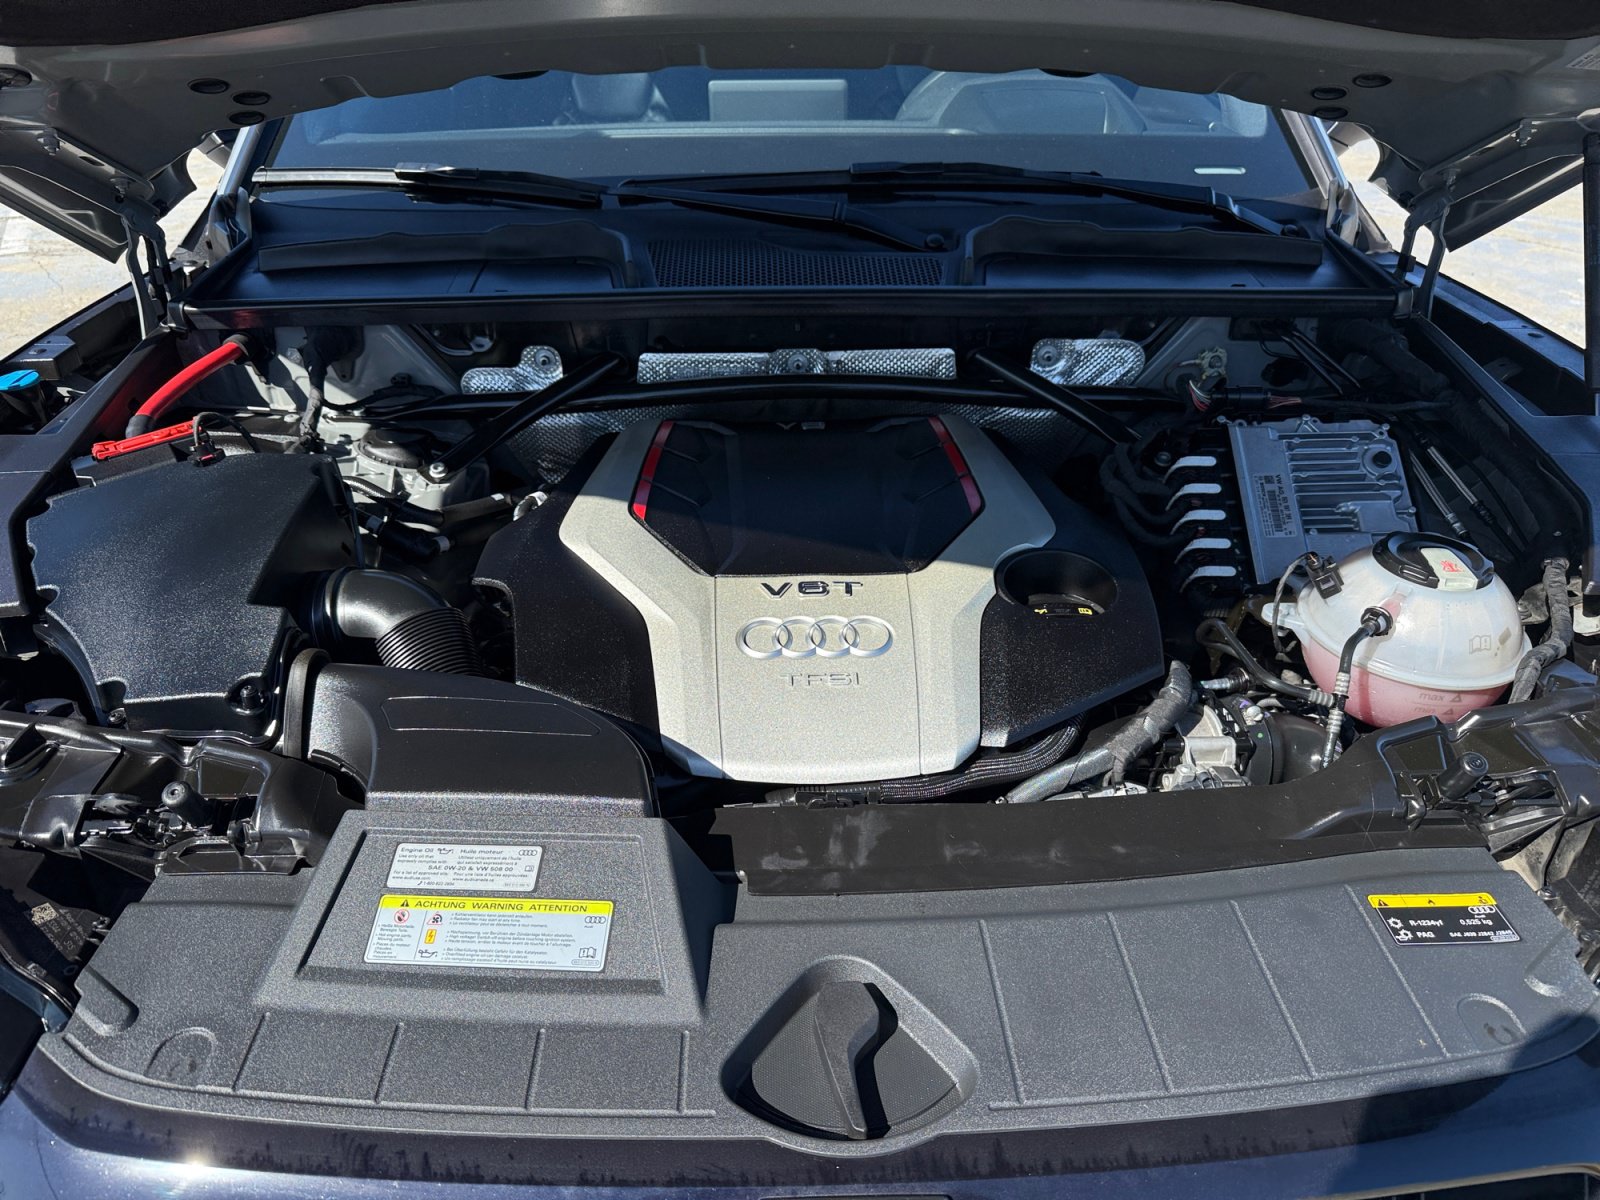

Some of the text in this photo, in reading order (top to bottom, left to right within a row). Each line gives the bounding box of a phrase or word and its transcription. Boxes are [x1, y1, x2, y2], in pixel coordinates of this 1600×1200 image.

[761, 581, 863, 598] V6T
[780, 673, 859, 686] TFSI
[1419, 693, 1445, 701] max
